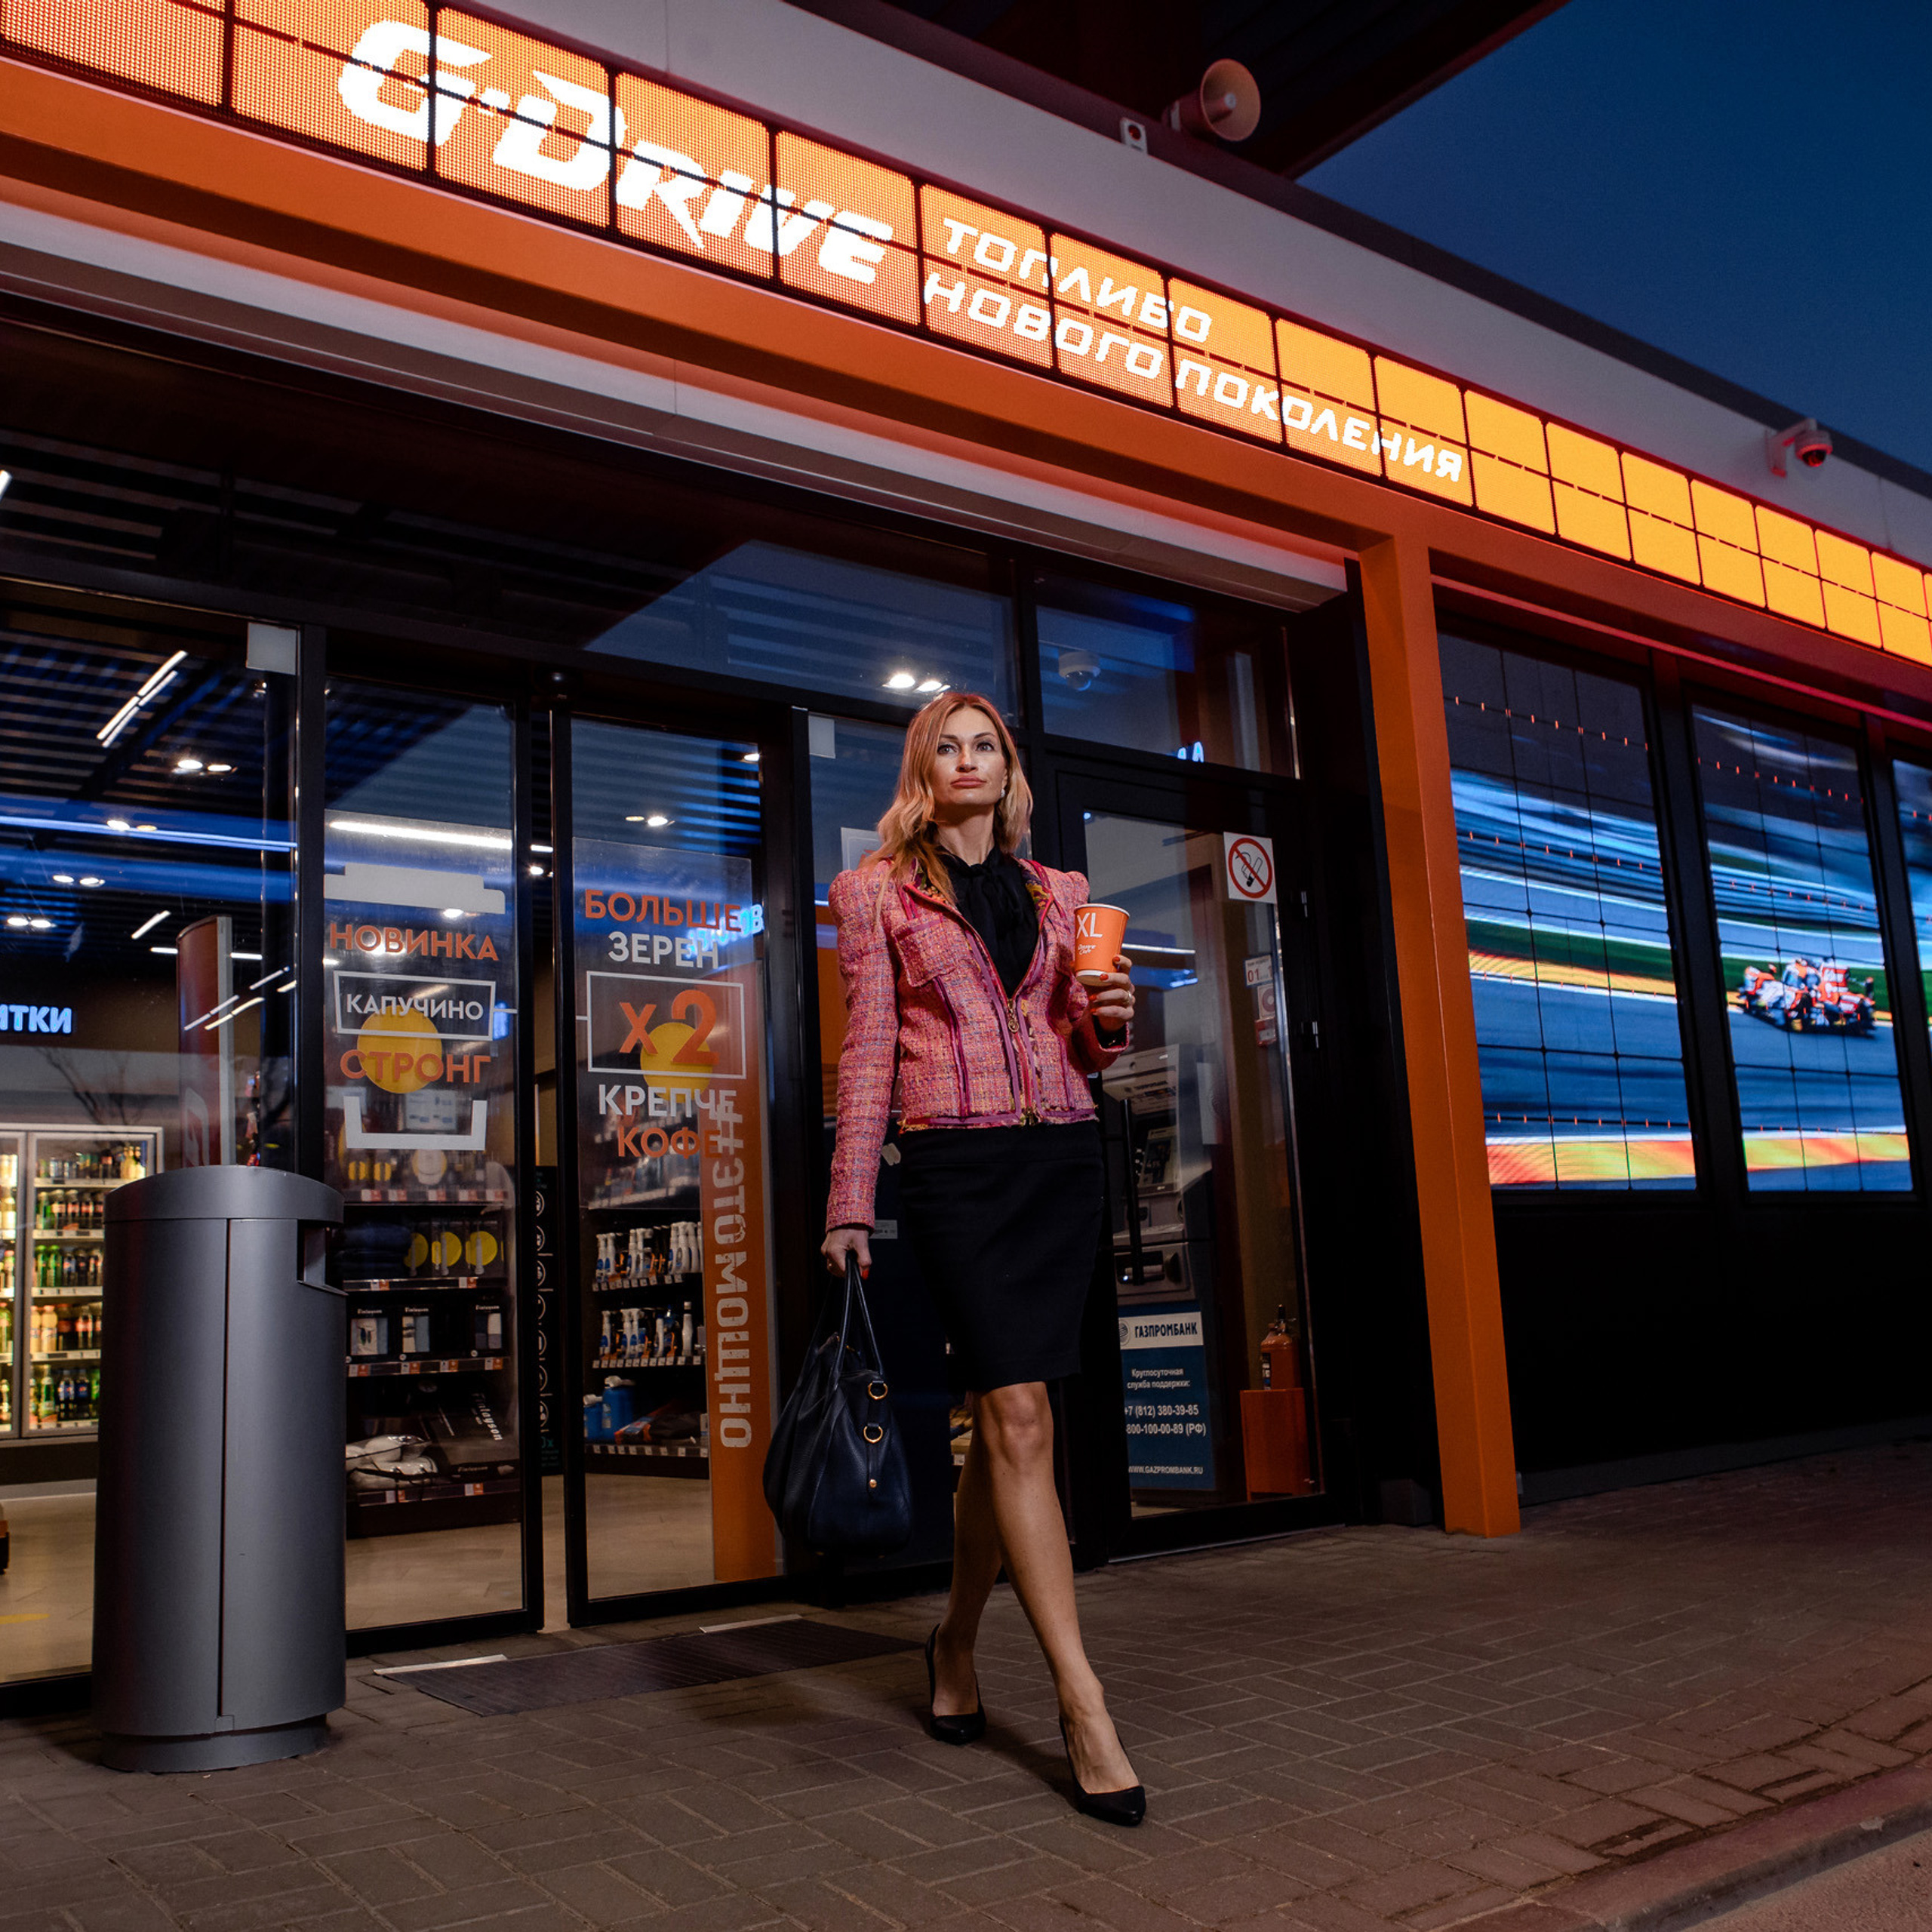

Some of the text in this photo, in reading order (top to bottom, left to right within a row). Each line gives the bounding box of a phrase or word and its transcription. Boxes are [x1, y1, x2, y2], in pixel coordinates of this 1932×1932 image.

[943, 217, 1213, 343] ТОПЛИВО
[923, 273, 1463, 482] НОВОГО ПОКОЛЕНИЯ
[584, 889, 743, 932] БОЛЬШЕ
[1075, 912, 1103, 940] XL
[329, 923, 500, 961] НОВИНКА
[608, 931, 720, 969] ЗЕРЕН
[346, 992, 484, 1021] КАПУЧИНО
[339, 1049, 491, 1084] СТРОНГ
[598, 1083, 738, 1120] КРЕПЧЕ
[616, 1128, 721, 1160] КОФЕ
[1134, 1321, 1198, 1338] ГАЗПРОМБАНК
[1135, 1404, 1156, 1419] (812)
[1157, 1404, 1199, 1416] 380-39-85
[1185, 1423, 1207, 1437] (РФ)
